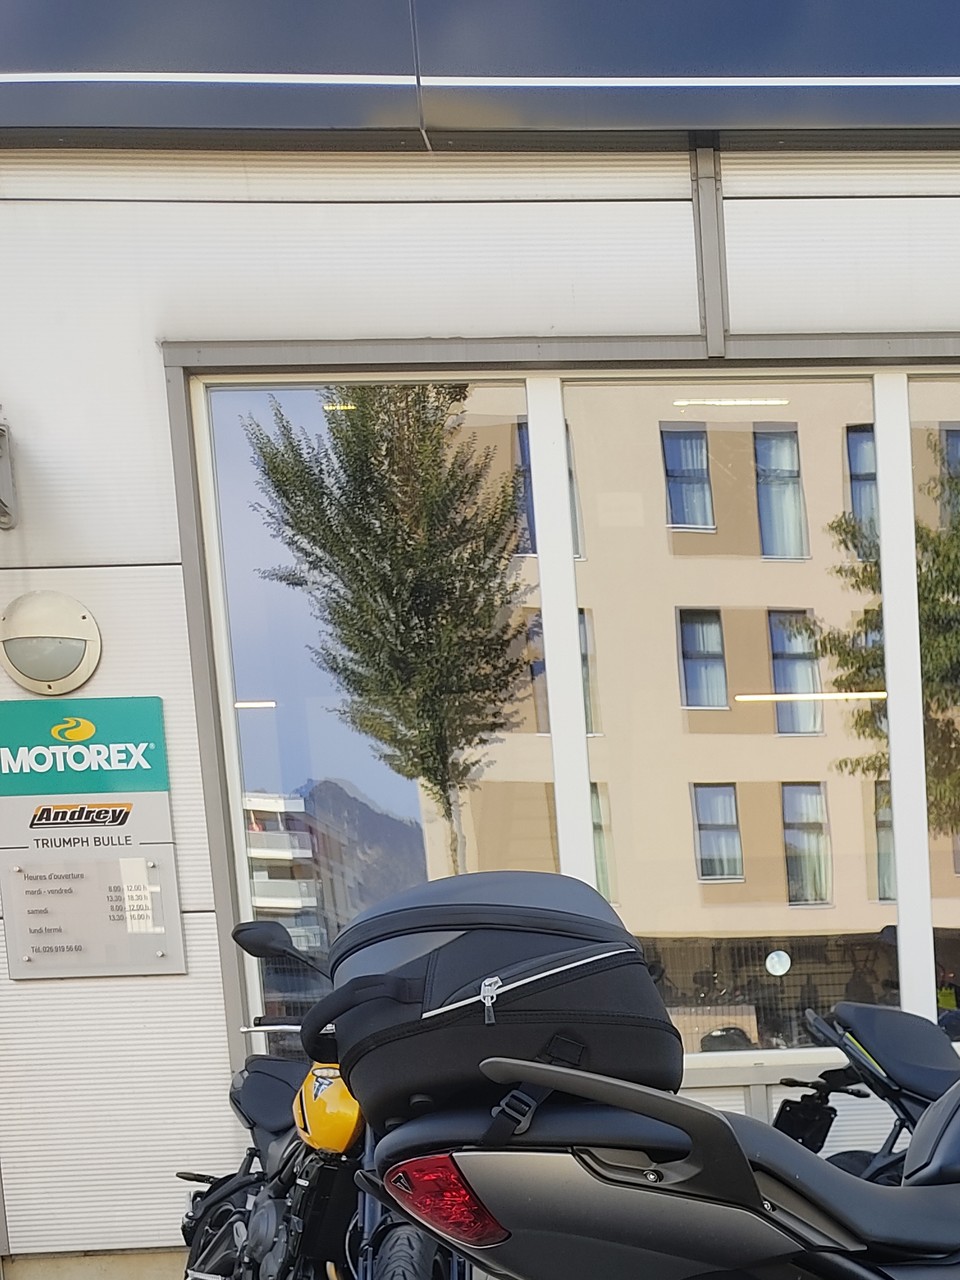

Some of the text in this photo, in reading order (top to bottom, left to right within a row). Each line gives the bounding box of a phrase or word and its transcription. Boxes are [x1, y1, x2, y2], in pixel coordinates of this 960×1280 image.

[0, 742, 152, 774] MOTOREX
[36, 805, 127, 826] Andrey
[33, 835, 133, 849] TRIUMPH BULLE
[23, 871, 85, 881] Heures d'ouverture
[25, 888, 43, 896] mardi
[48, 887, 74, 895] vendredi
